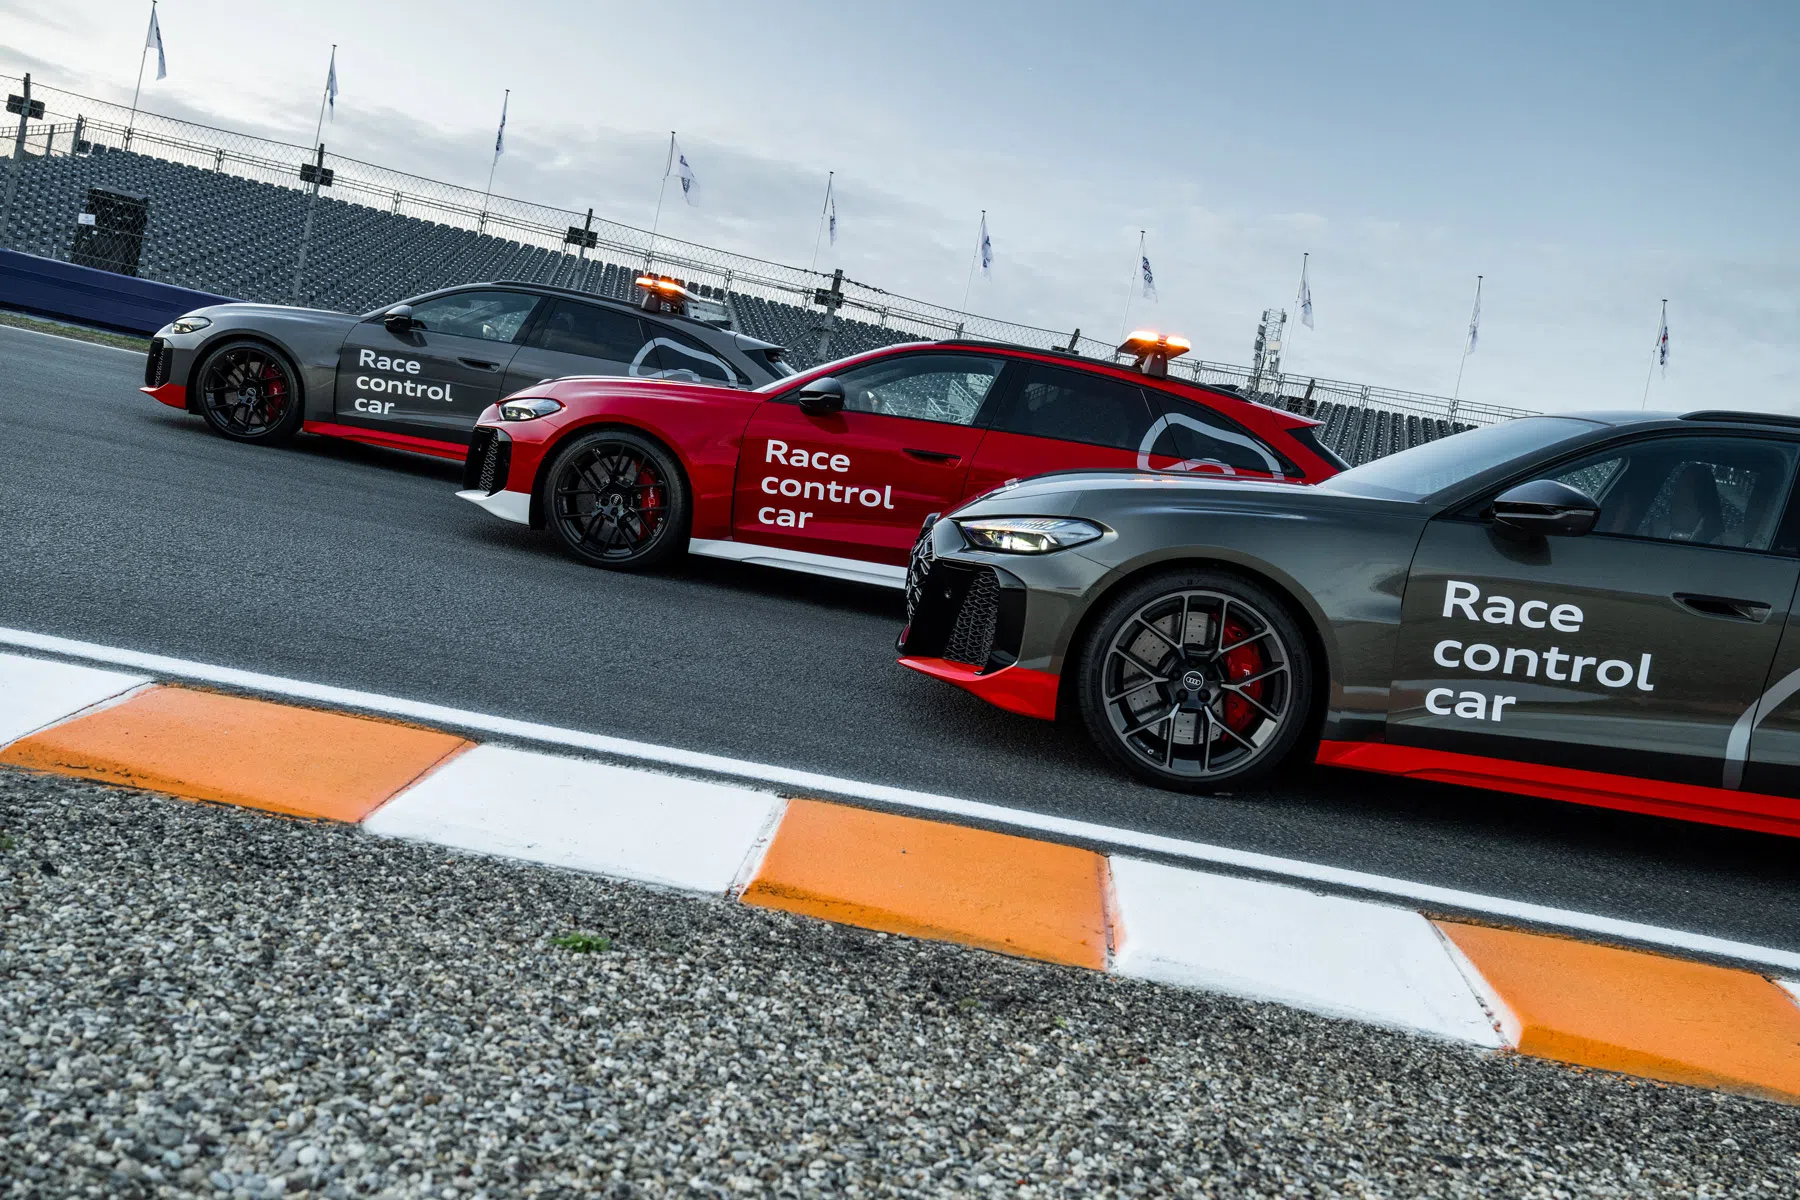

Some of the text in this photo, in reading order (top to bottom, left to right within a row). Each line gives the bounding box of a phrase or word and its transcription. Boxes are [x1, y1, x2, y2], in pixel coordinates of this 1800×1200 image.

[359, 348, 421, 375] Race
[356, 375, 453, 402] control
[354, 398, 395, 415] car
[765, 439, 851, 473] Race
[761, 476, 894, 510] control
[758, 506, 814, 529] car
[1442, 579, 1584, 633] Race
[1433, 639, 1654, 691] control
[1425, 687, 1517, 722] car
